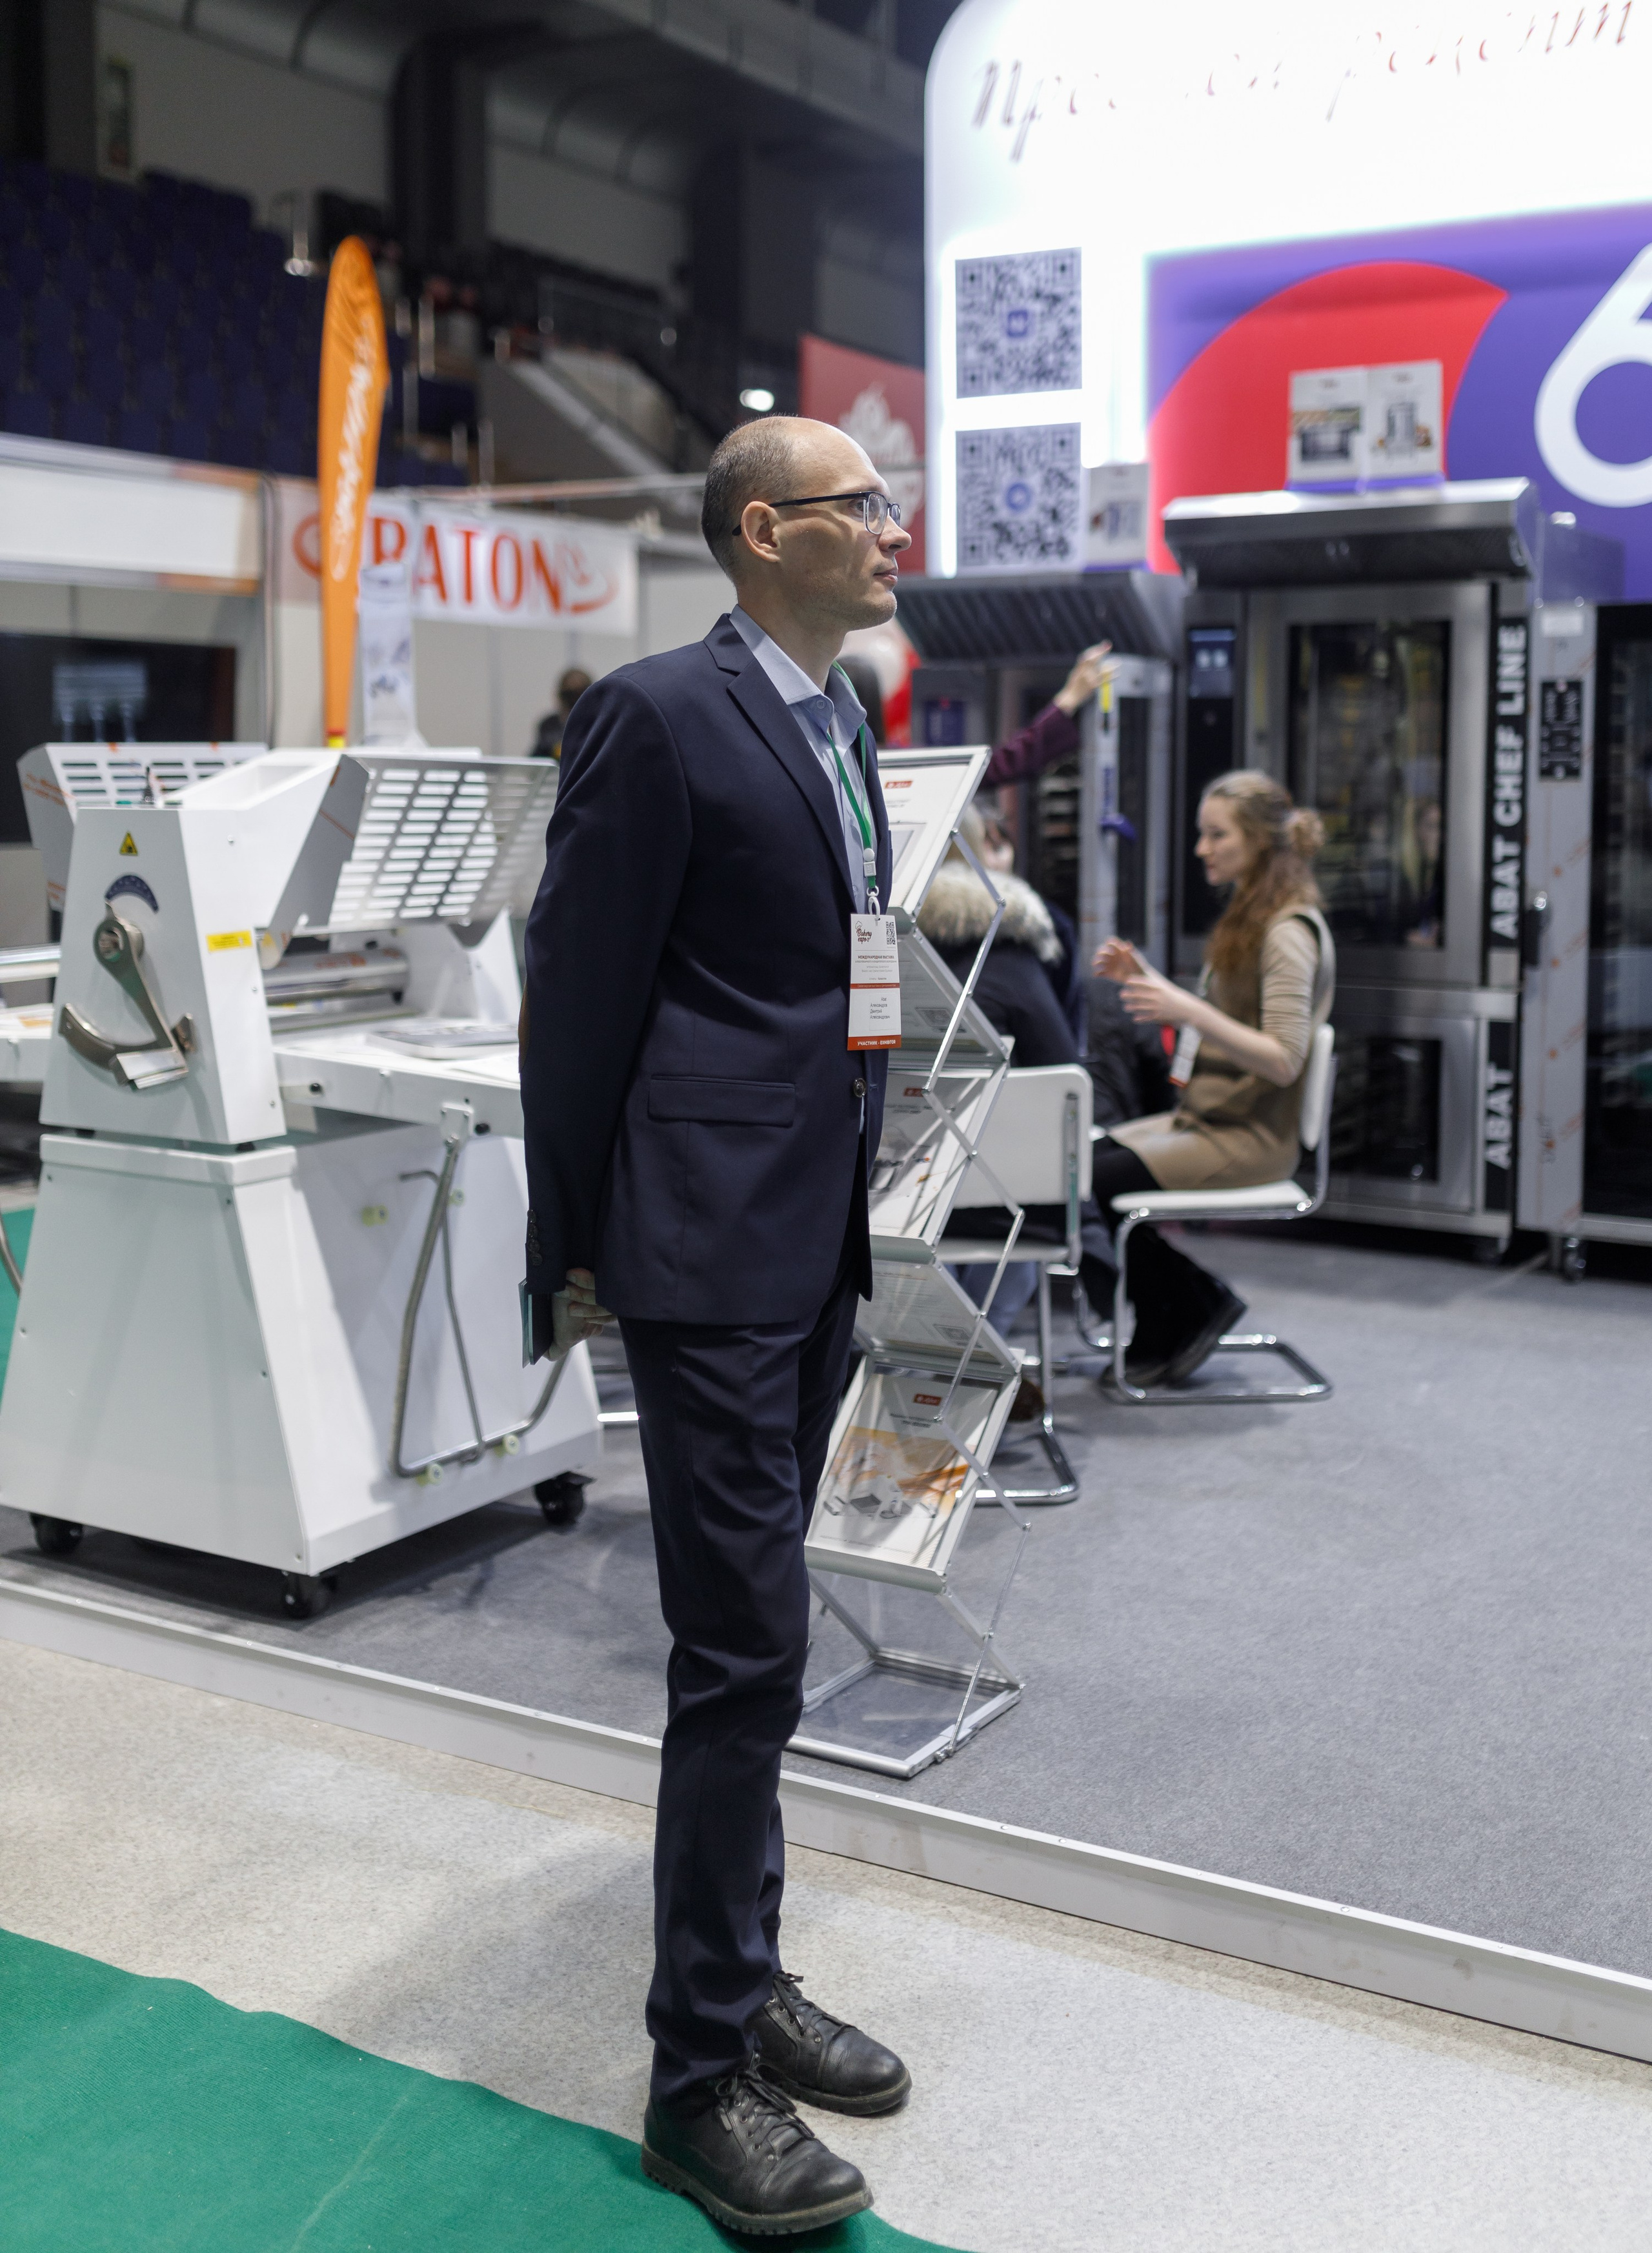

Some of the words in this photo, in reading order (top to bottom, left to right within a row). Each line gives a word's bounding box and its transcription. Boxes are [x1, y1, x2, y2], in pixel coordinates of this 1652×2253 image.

[1496, 623, 1527, 716] LINE
[1493, 724, 1524, 827] CHEF
[856, 928, 872, 939] Bakery
[1490, 837, 1522, 942] ABAT
[1485, 1060, 1514, 1170] ABAT
